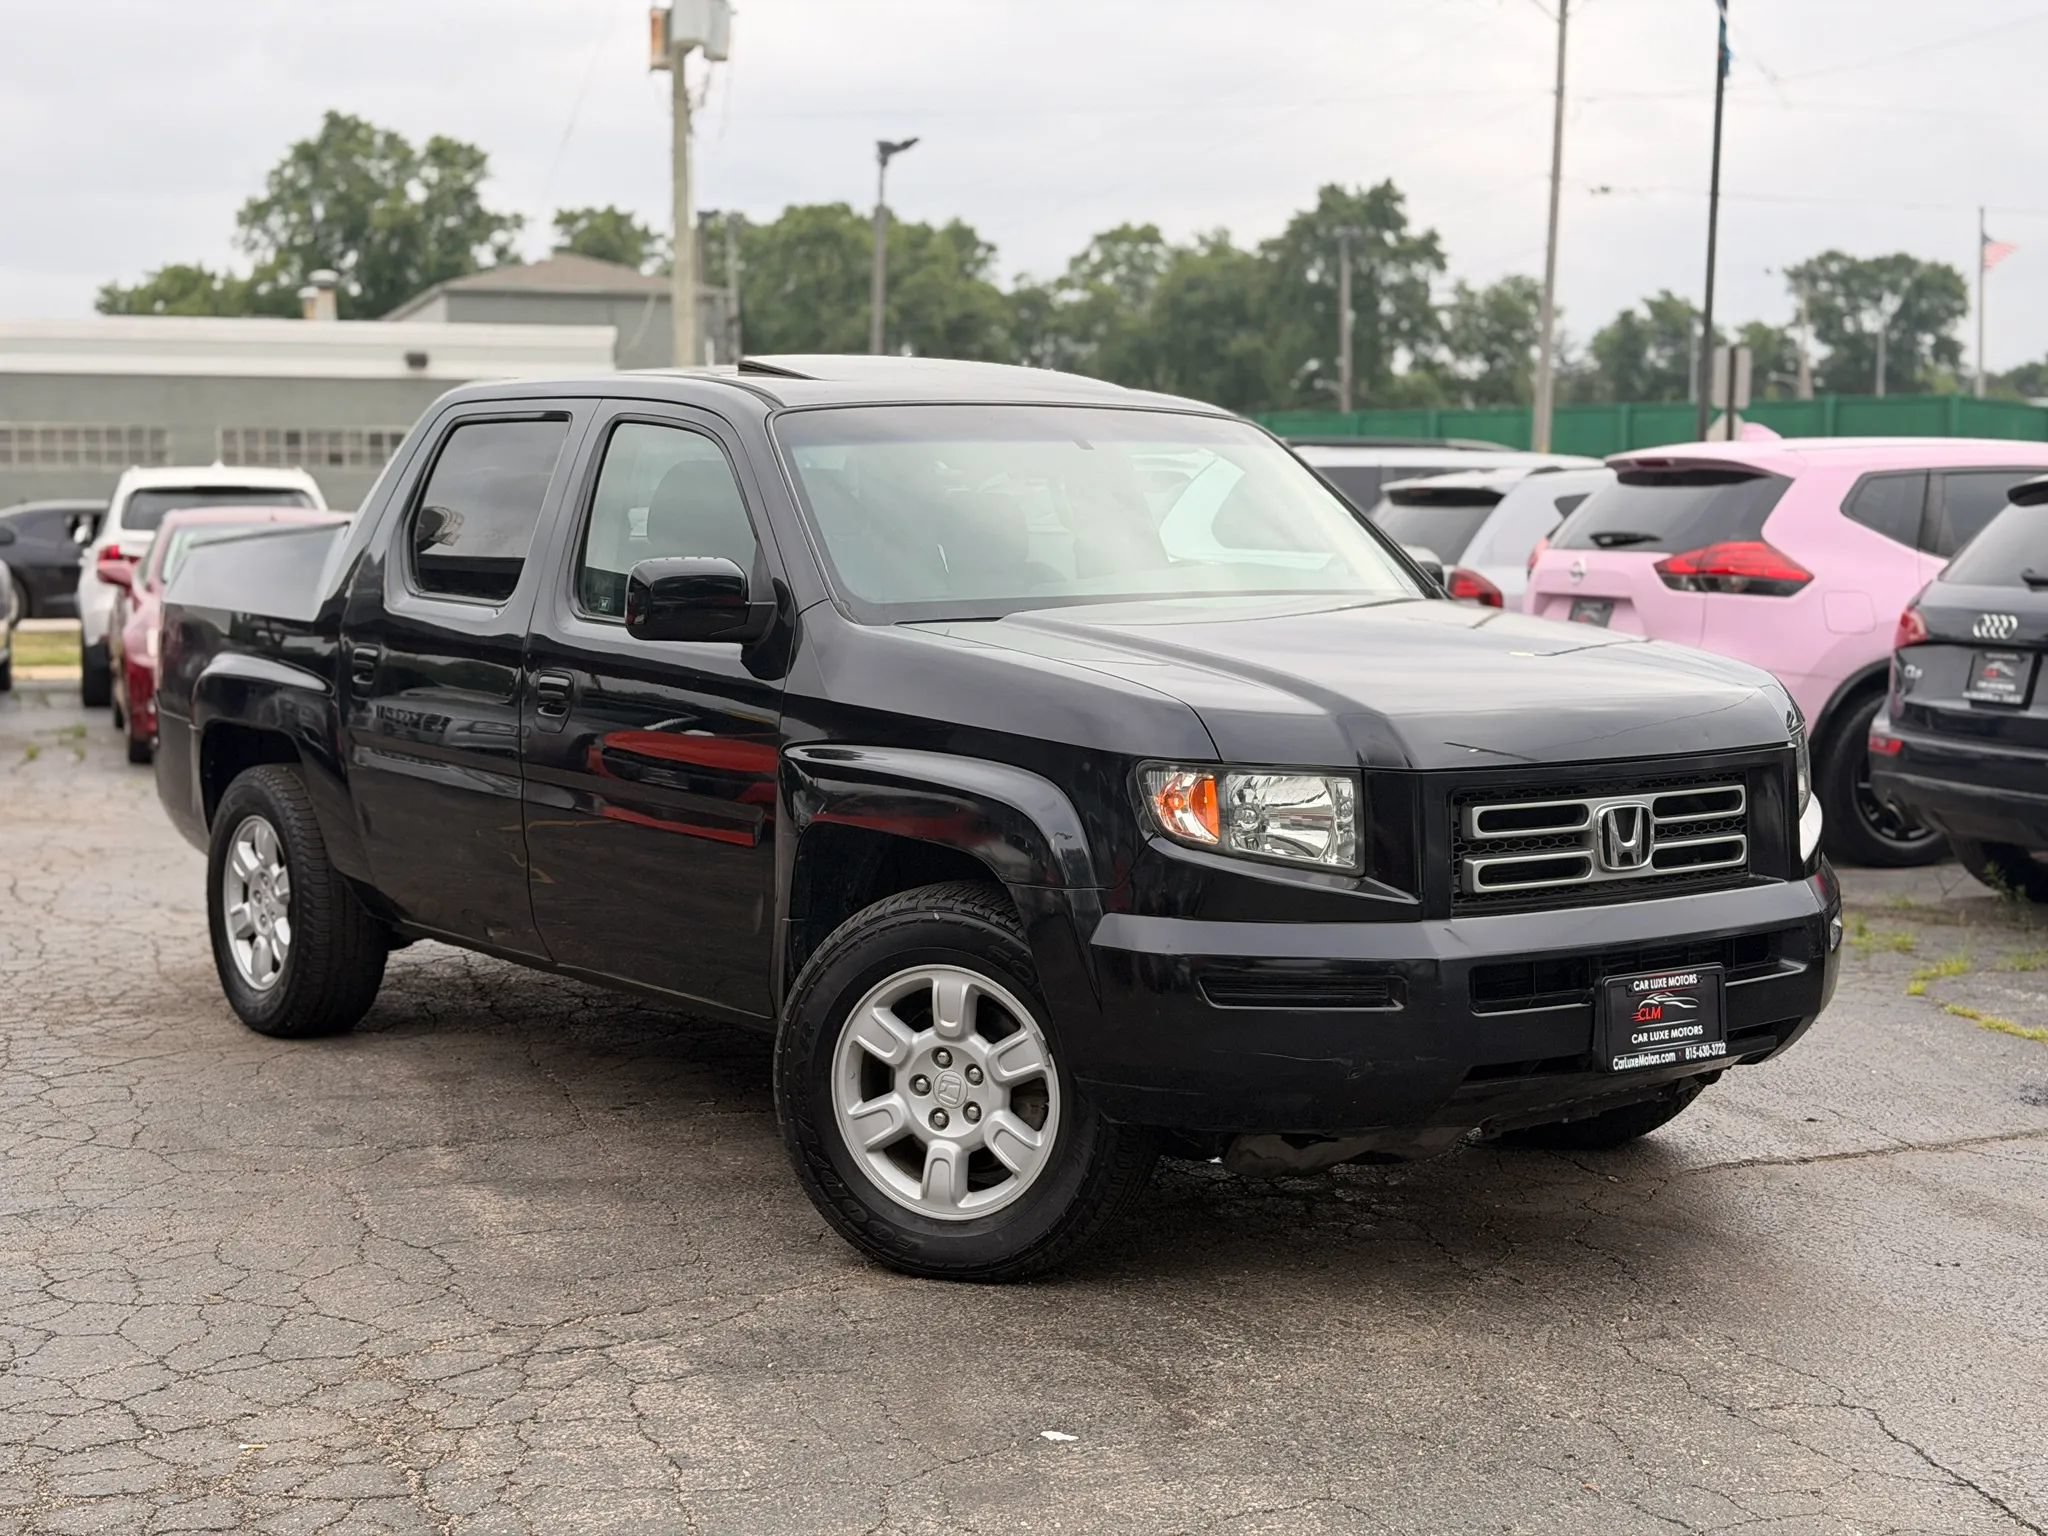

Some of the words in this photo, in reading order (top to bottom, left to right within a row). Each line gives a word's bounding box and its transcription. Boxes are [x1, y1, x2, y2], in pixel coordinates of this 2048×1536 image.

[1633, 980, 1649, 992] CAR
[1650, 977, 1667, 989] LUXE
[1668, 973, 1697, 987] MOTORS
[1638, 1006, 1662, 1021] CLM
[1631, 1032, 1648, 1044] CAR
[1650, 1029, 1669, 1041] LUXE
[1670, 1025, 1703, 1039] MOTORS
[1613, 1051, 1676, 1071] CarLuxeMotors.com
[1685, 1042, 1726, 1060] 815-630-3722
